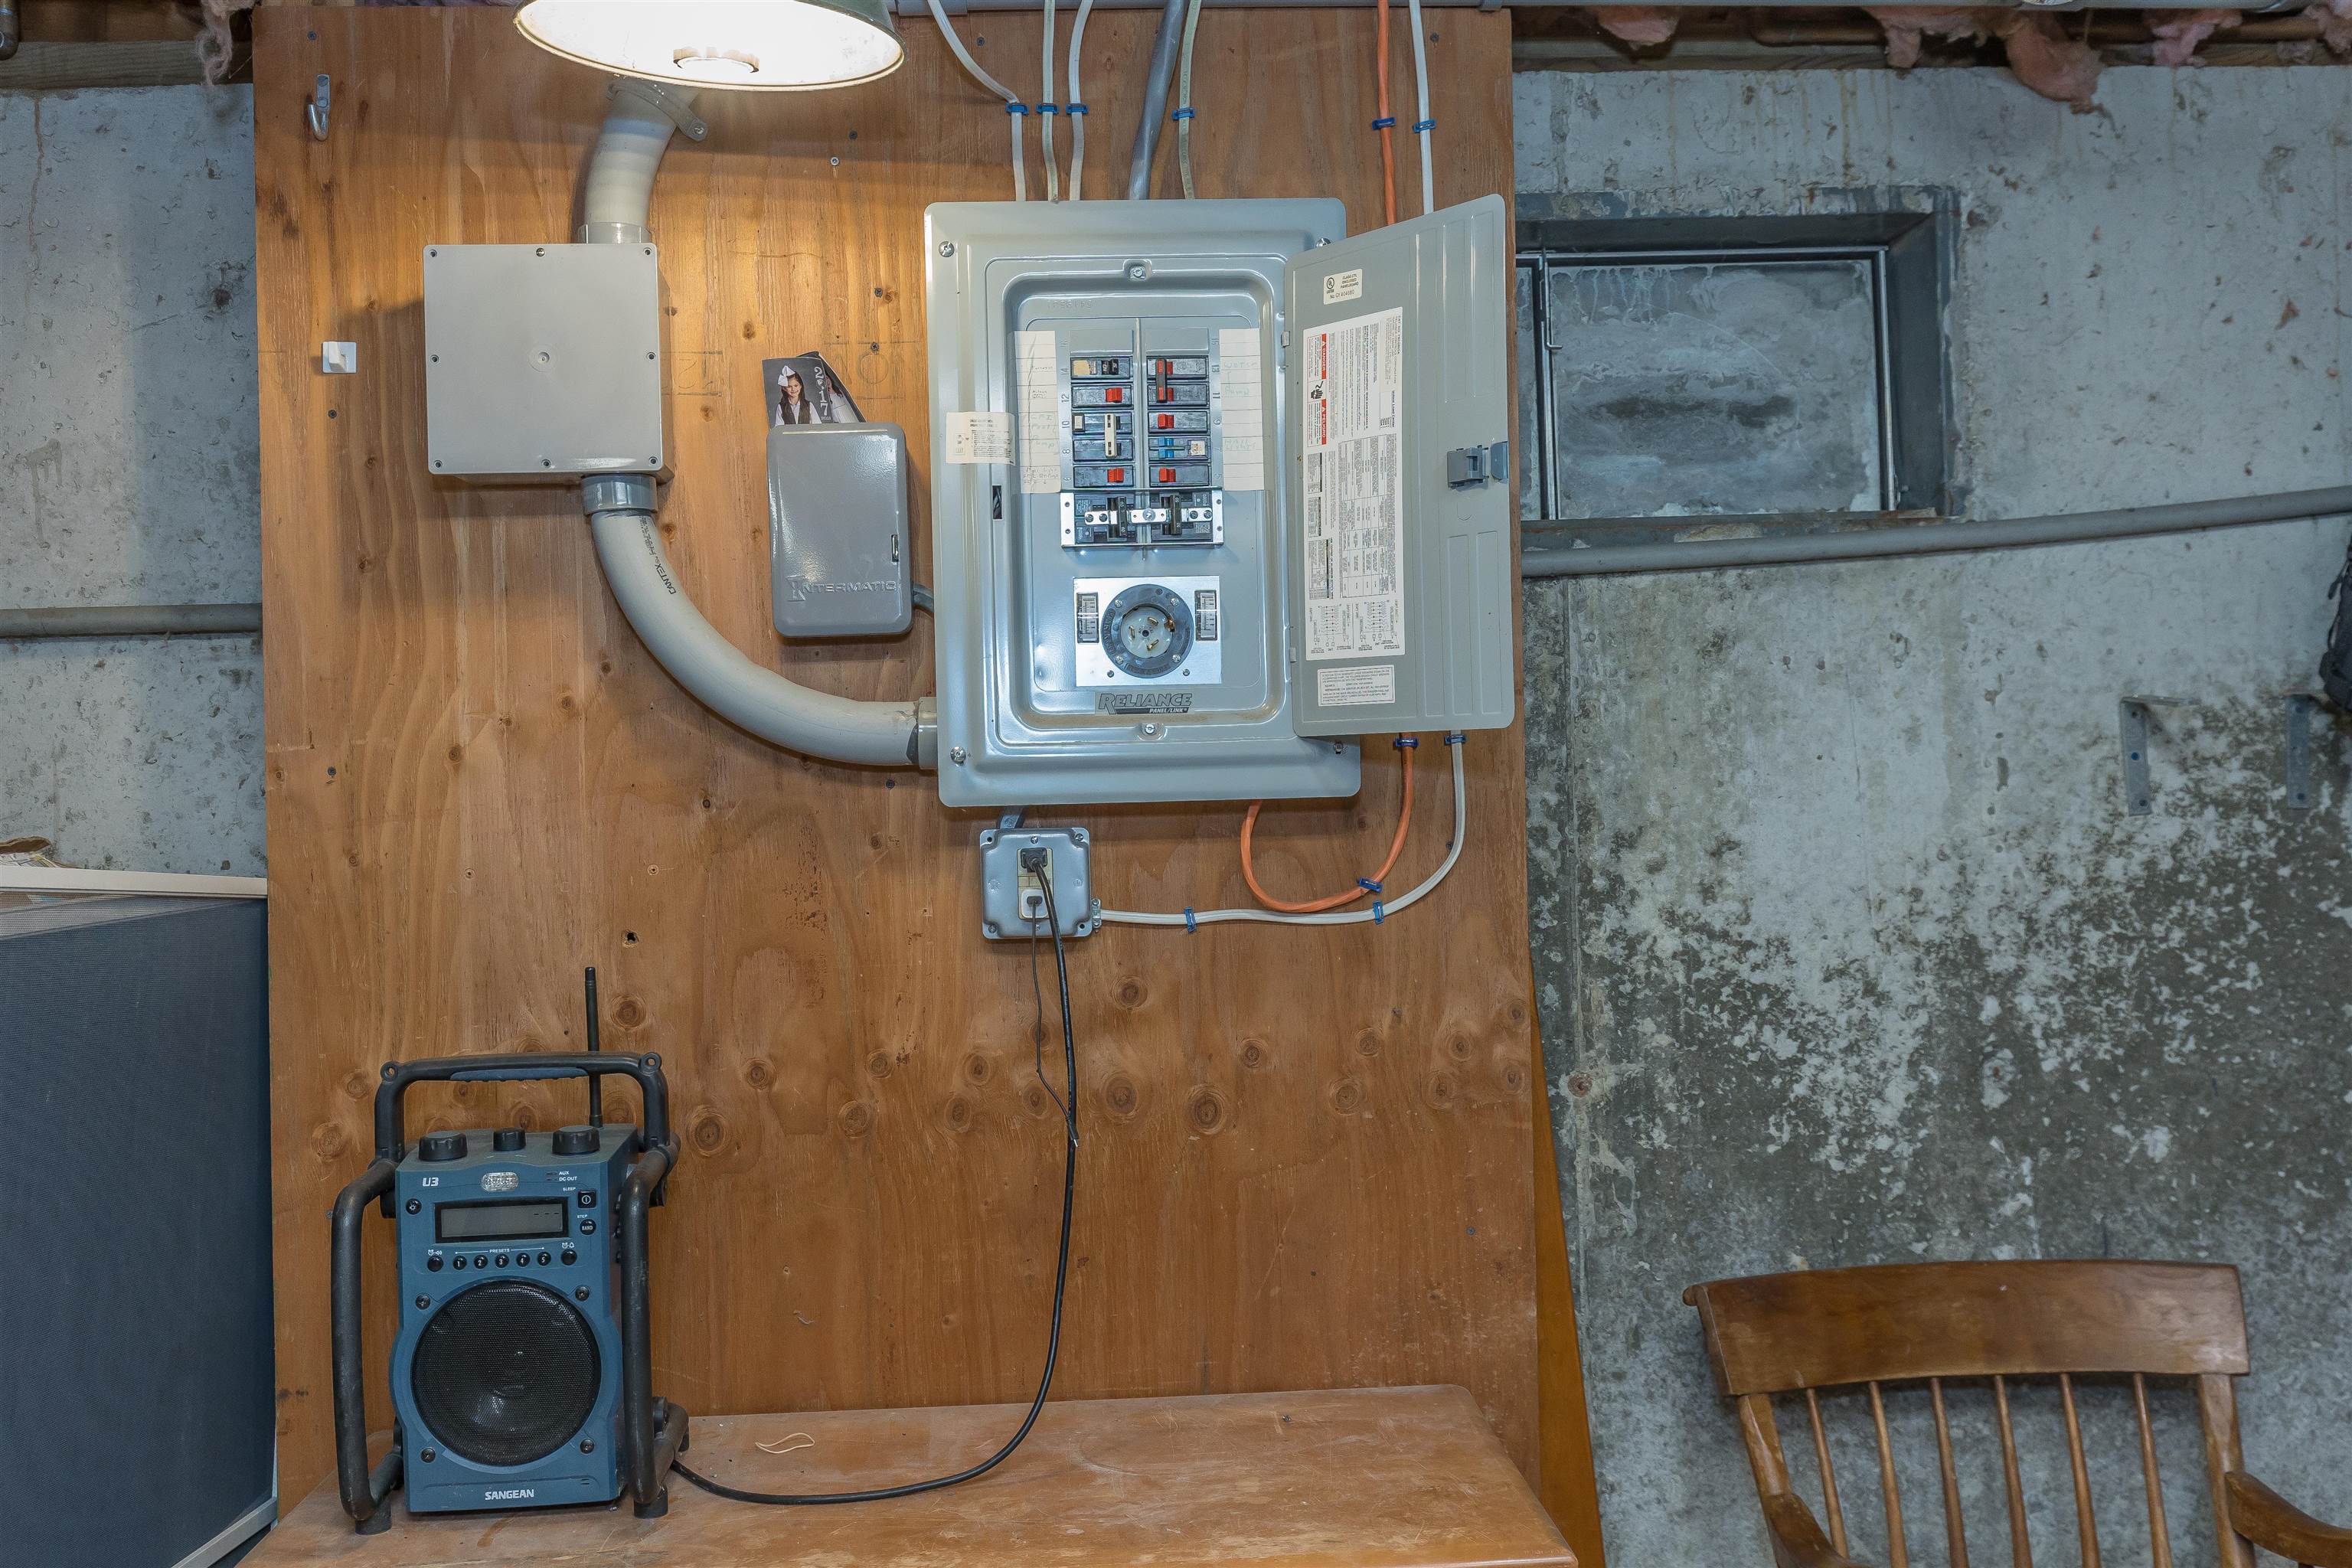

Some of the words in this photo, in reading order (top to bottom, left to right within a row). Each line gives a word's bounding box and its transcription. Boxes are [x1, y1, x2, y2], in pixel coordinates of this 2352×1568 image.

[1061, 393, 1070, 403] 12
[1062, 420, 1070, 429] 10
[655, 564, 677, 594] CANTEX
[786, 574, 897, 601] INTERMATIC
[1099, 693, 1192, 714] RELIANCE
[423, 1177, 439, 1187] U3
[485, 1488, 534, 1501] SANGEAN
